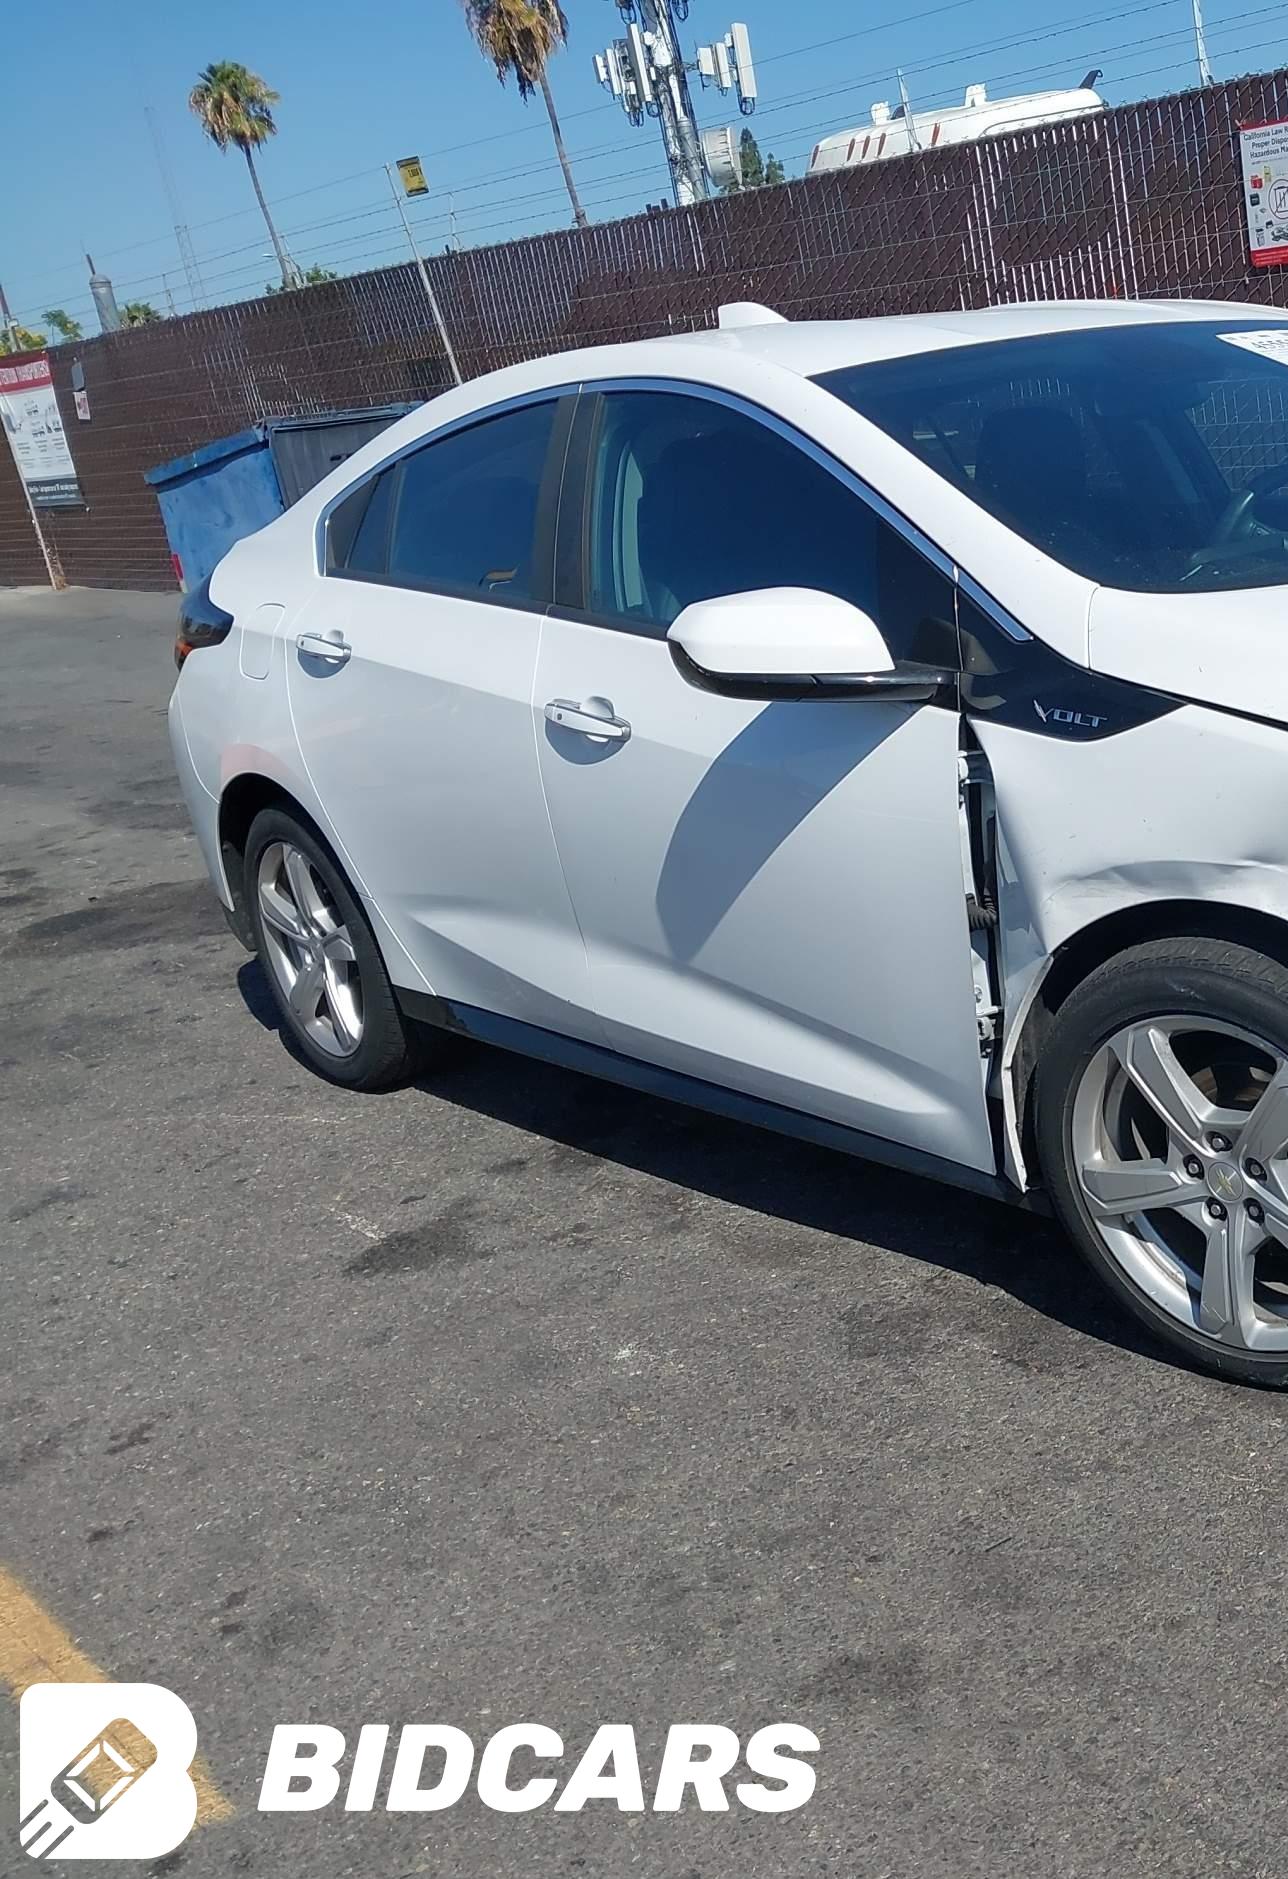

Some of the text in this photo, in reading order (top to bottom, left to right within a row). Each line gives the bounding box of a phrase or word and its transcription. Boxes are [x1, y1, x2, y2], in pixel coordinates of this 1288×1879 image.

[1244, 131, 1270, 140] California
[1252, 140, 1270, 149] Proper
[1250, 148, 1280, 159] Hazardous
[1033, 700, 1108, 728] VOLT
